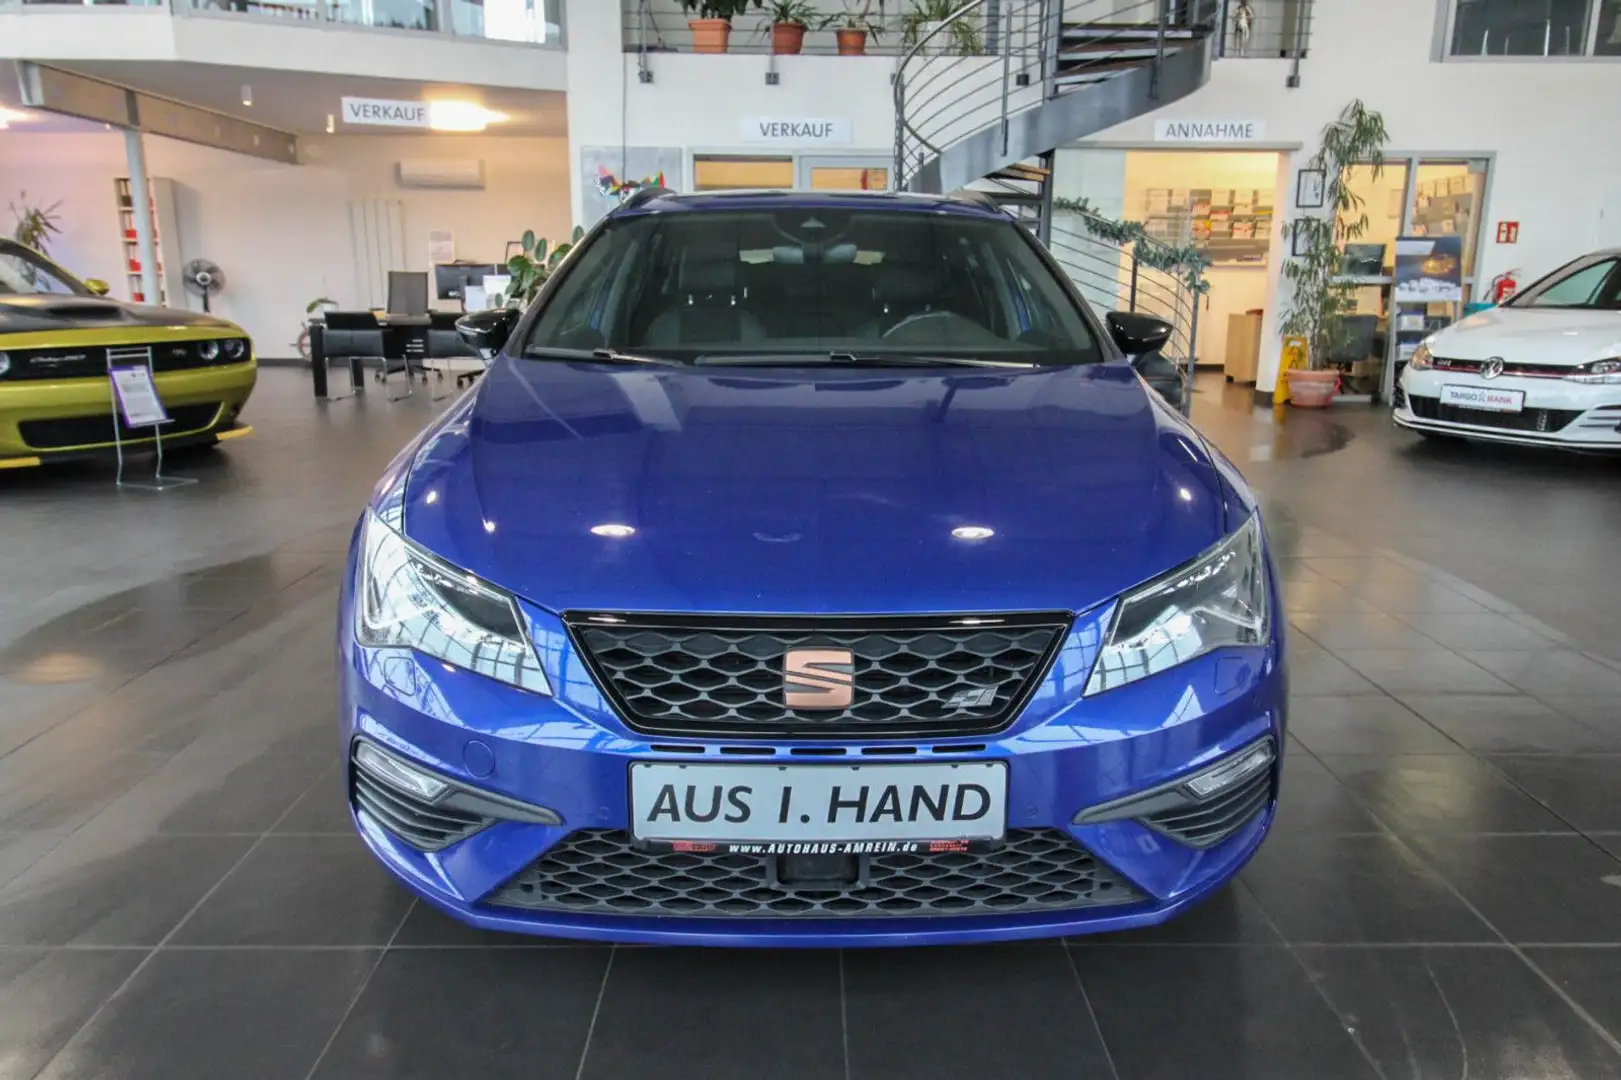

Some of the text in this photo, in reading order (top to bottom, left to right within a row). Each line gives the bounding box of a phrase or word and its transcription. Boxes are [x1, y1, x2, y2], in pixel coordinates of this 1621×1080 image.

[350, 103, 425, 122] VERKAUF
[759, 122, 833, 138] VERKAUF
[1165, 123, 1254, 139] ANNAHME
[1450, 390, 1513, 405] TARGO BANK
[646, 784, 752, 823] AUS
[827, 783, 991, 823] HAND
[728, 842, 918, 854] www.AUTOHAUS-AMREIN.de
